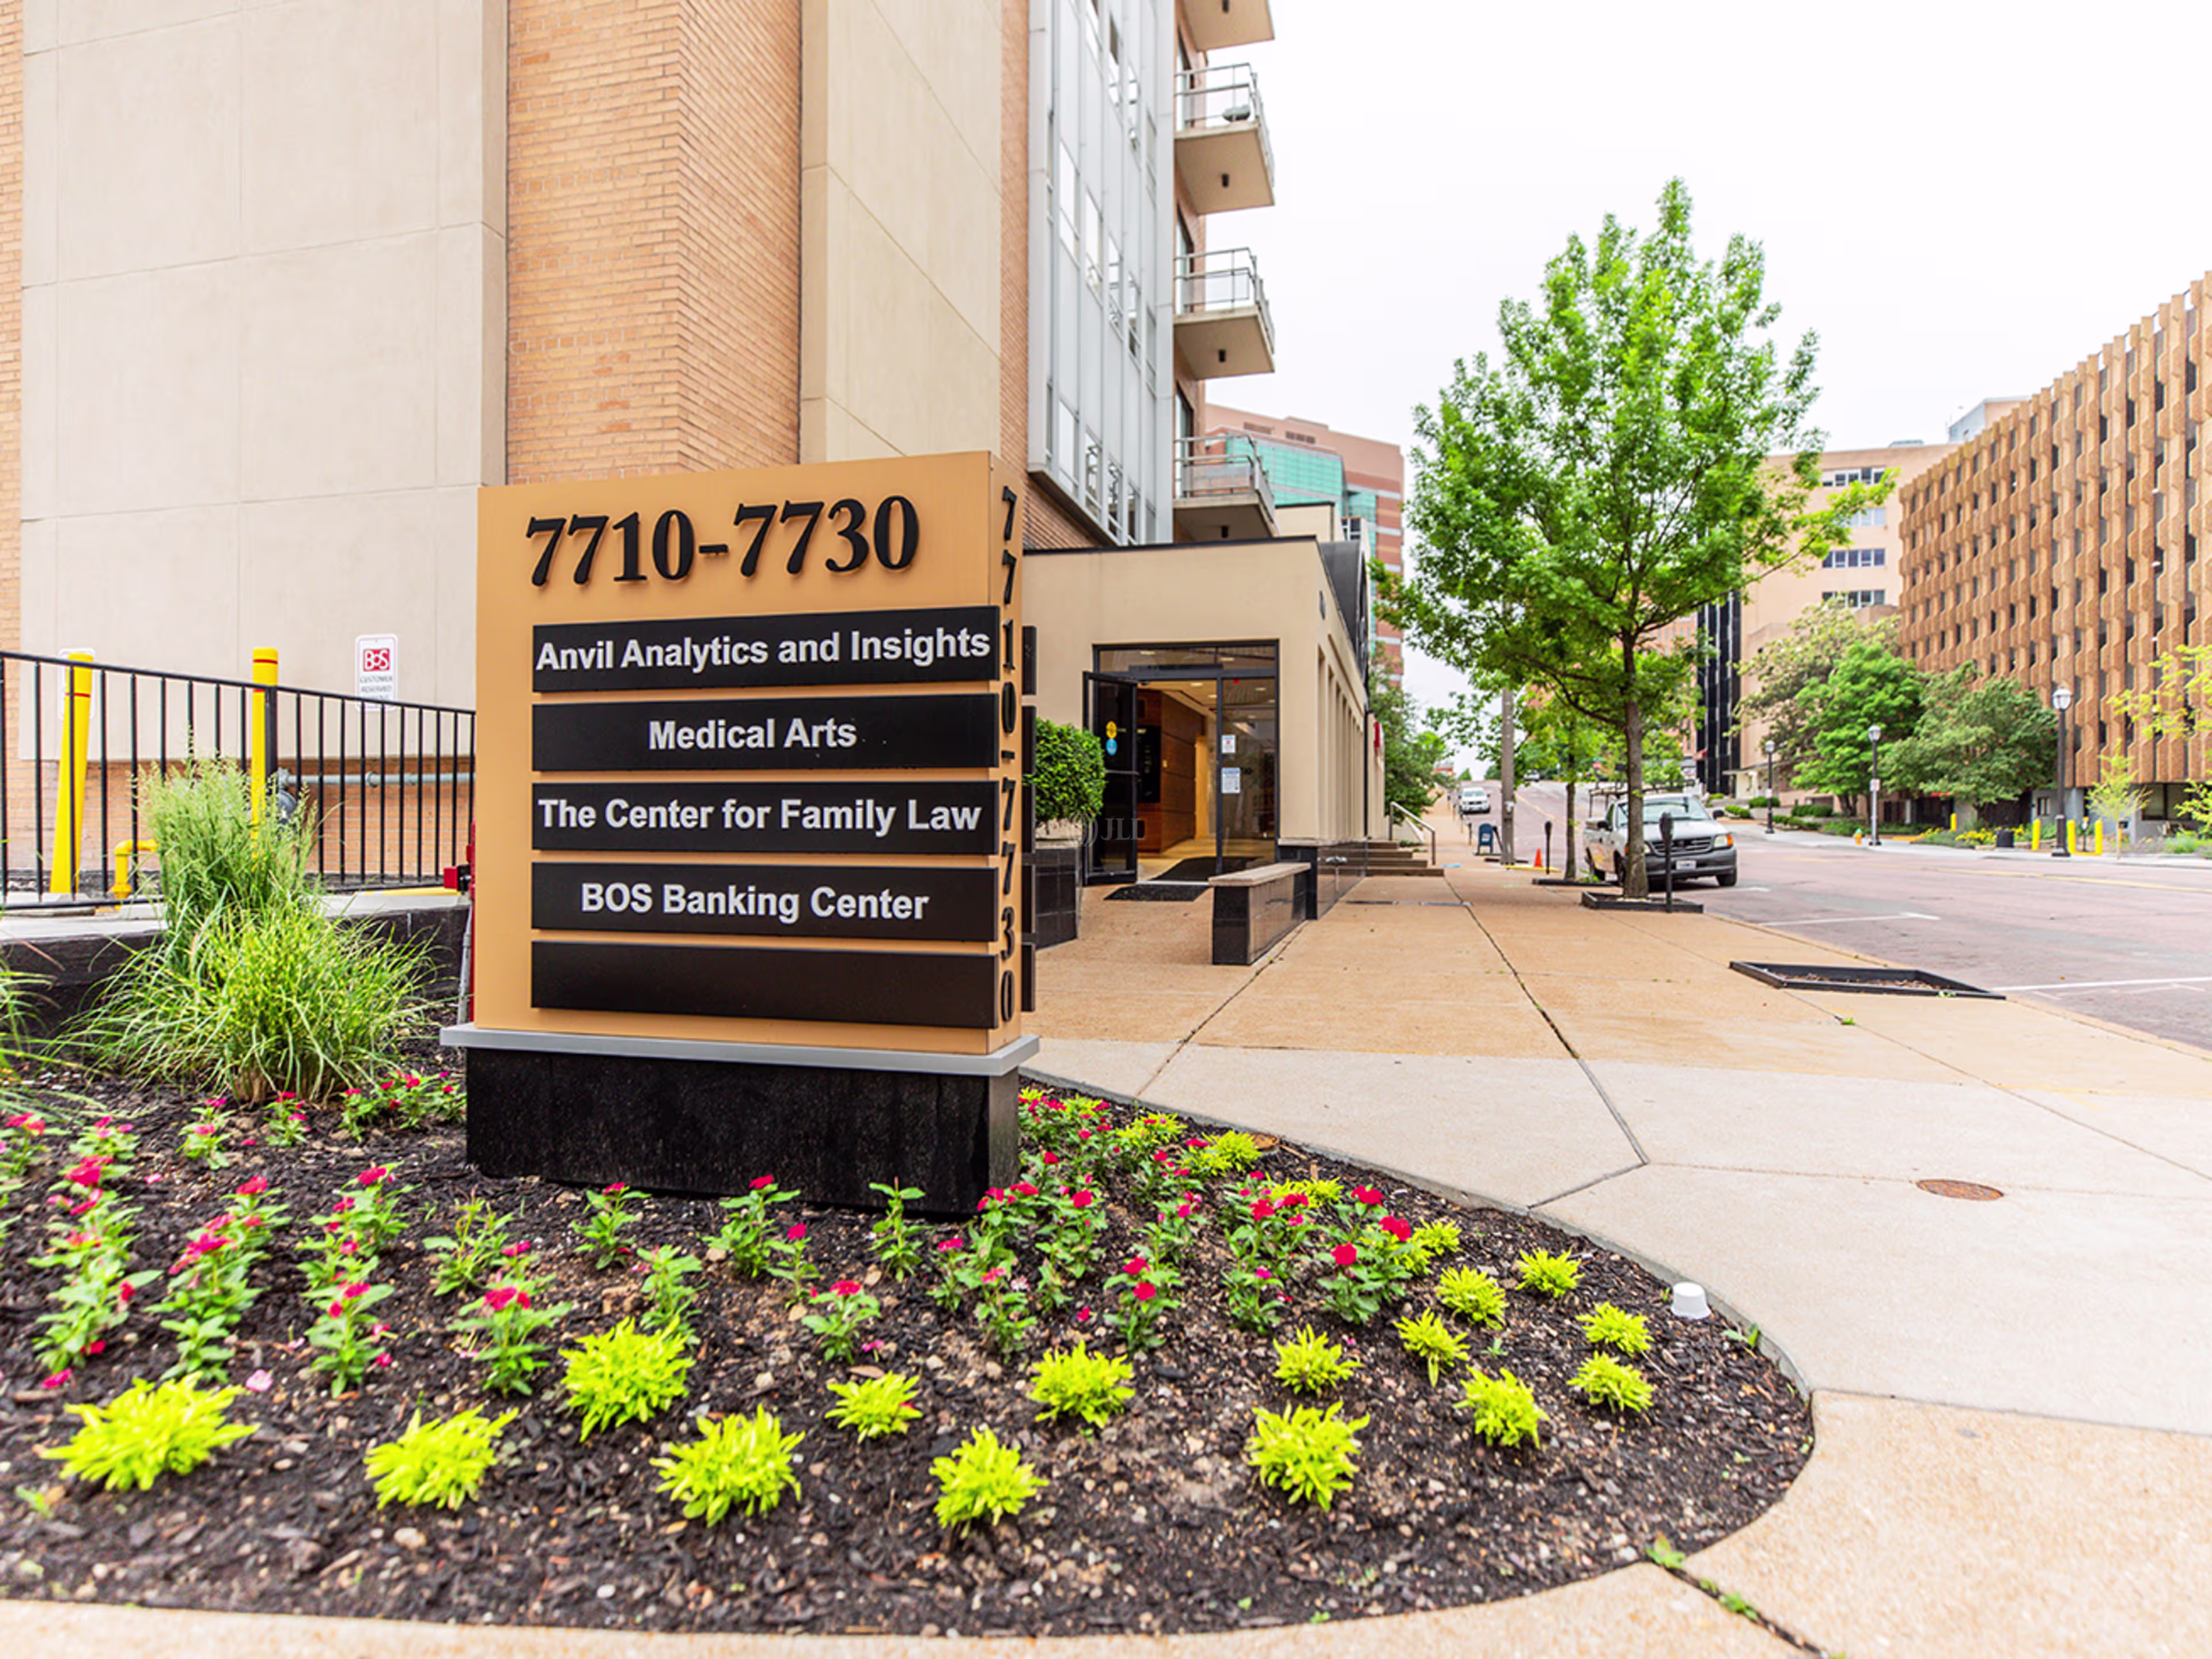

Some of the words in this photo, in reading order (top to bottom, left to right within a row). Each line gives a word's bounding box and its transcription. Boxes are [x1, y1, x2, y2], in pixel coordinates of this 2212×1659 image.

[526, 495, 919, 587] 7710-7730
[536, 640, 613, 671] Anvil
[620, 635, 768, 673] Analytics
[778, 631, 839, 663] and
[851, 627, 990, 666] Insights
[649, 719, 775, 749] Medical
[783, 718, 857, 748] Arts
[537, 799, 596, 828] The
[605, 799, 714, 828] Center
[722, 798, 771, 829] for
[781, 799, 896, 838] Family
[908, 799, 982, 830] Law
[582, 882, 653, 913] BOS
[663, 884, 800, 924] Banking
[810, 886, 930, 919] Center
